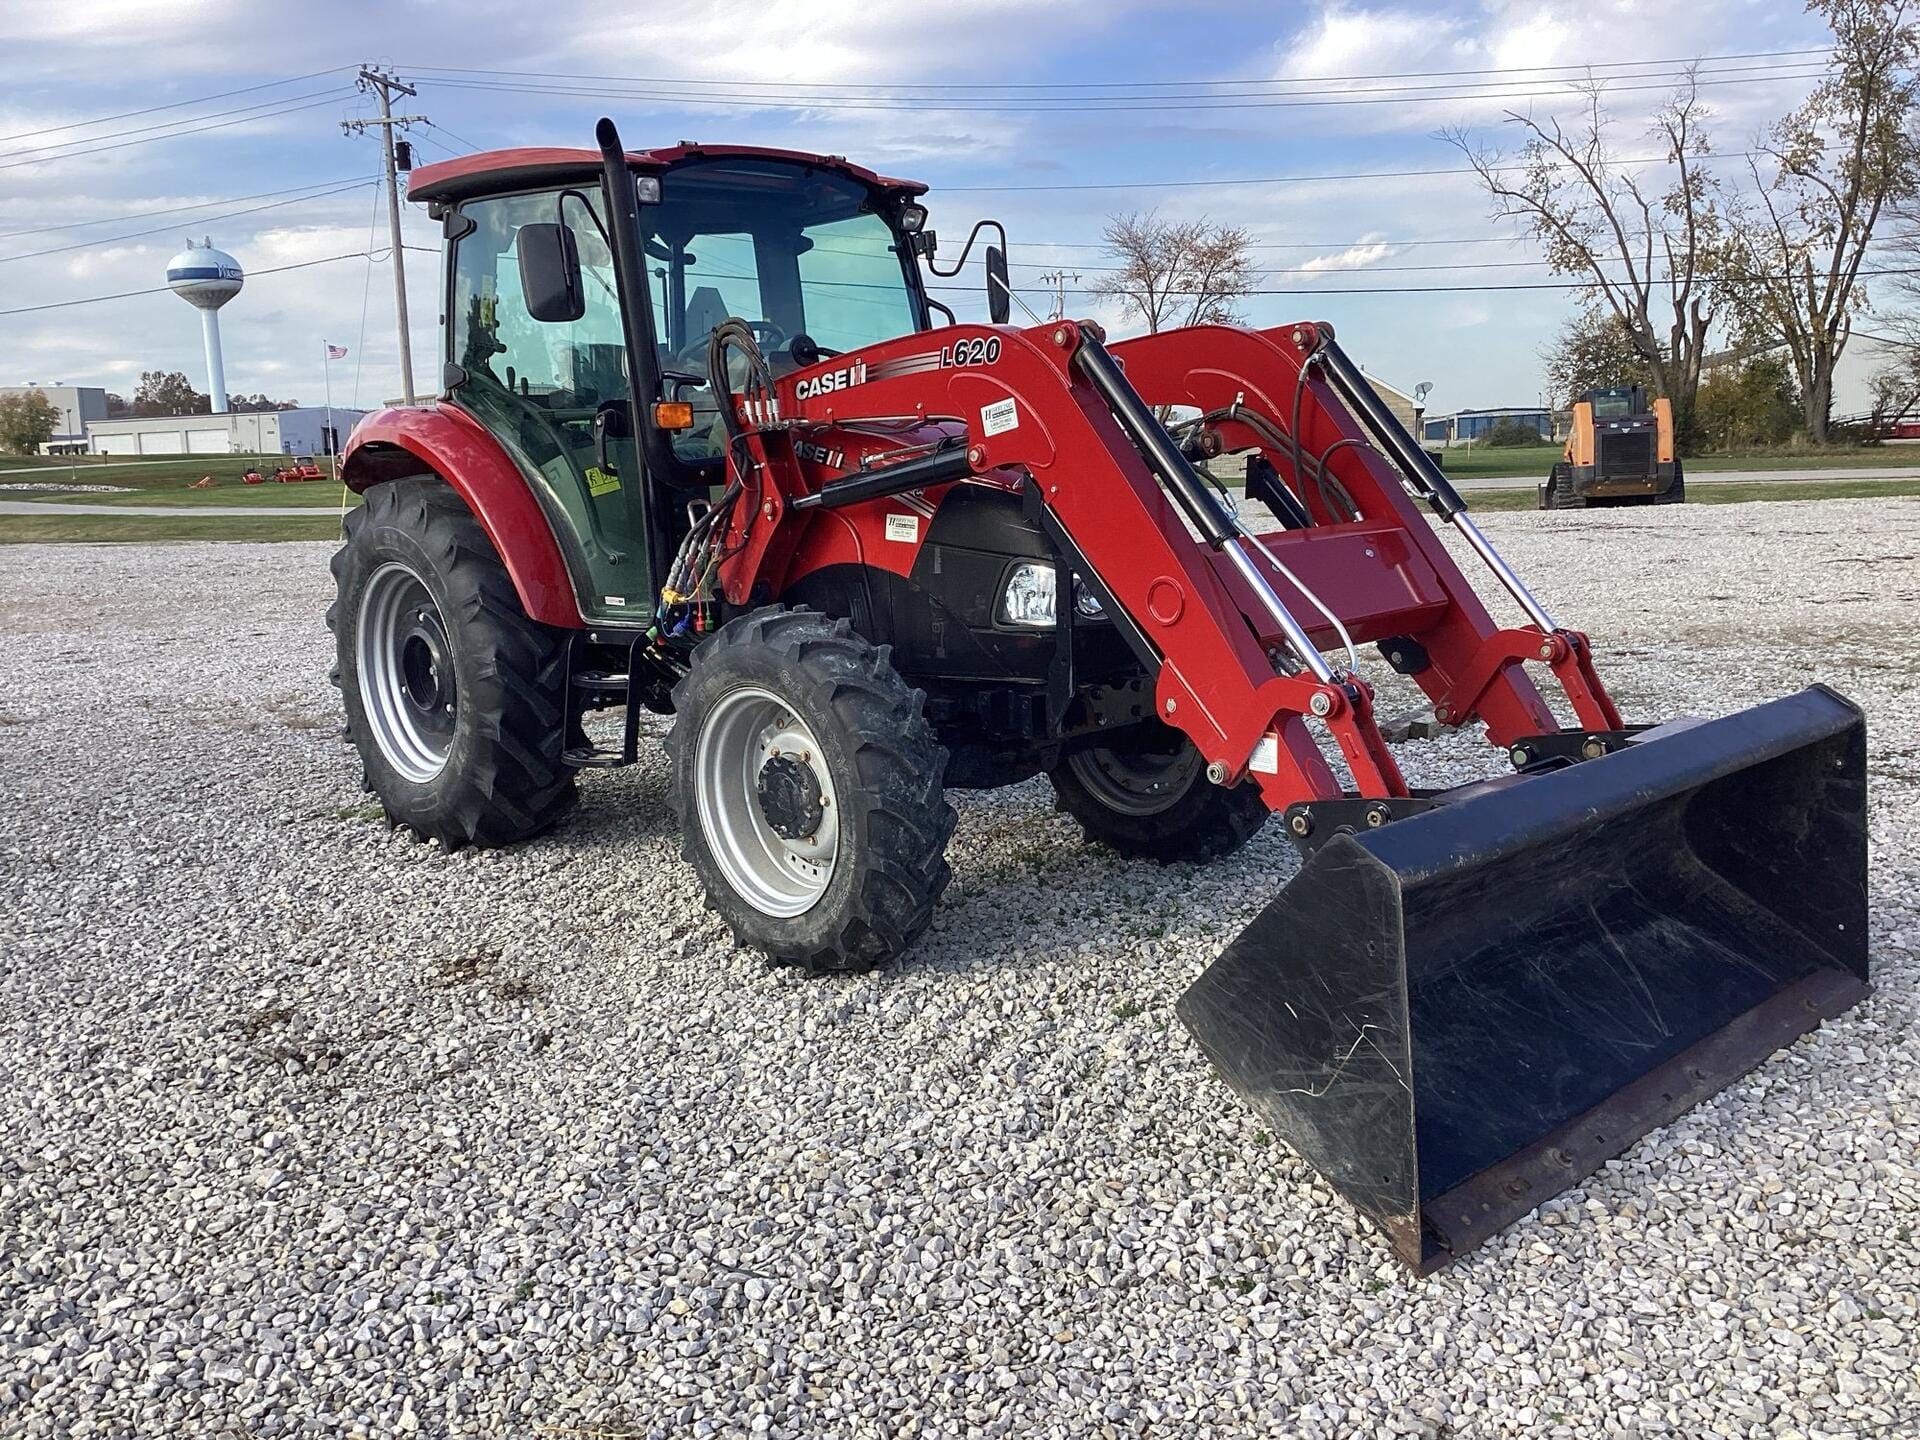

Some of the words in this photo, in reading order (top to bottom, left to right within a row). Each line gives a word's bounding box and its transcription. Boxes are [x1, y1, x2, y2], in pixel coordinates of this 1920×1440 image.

[940, 336, 1001, 370] L620
[795, 370, 848, 400] CASE
[793, 440, 827, 464] ASE
